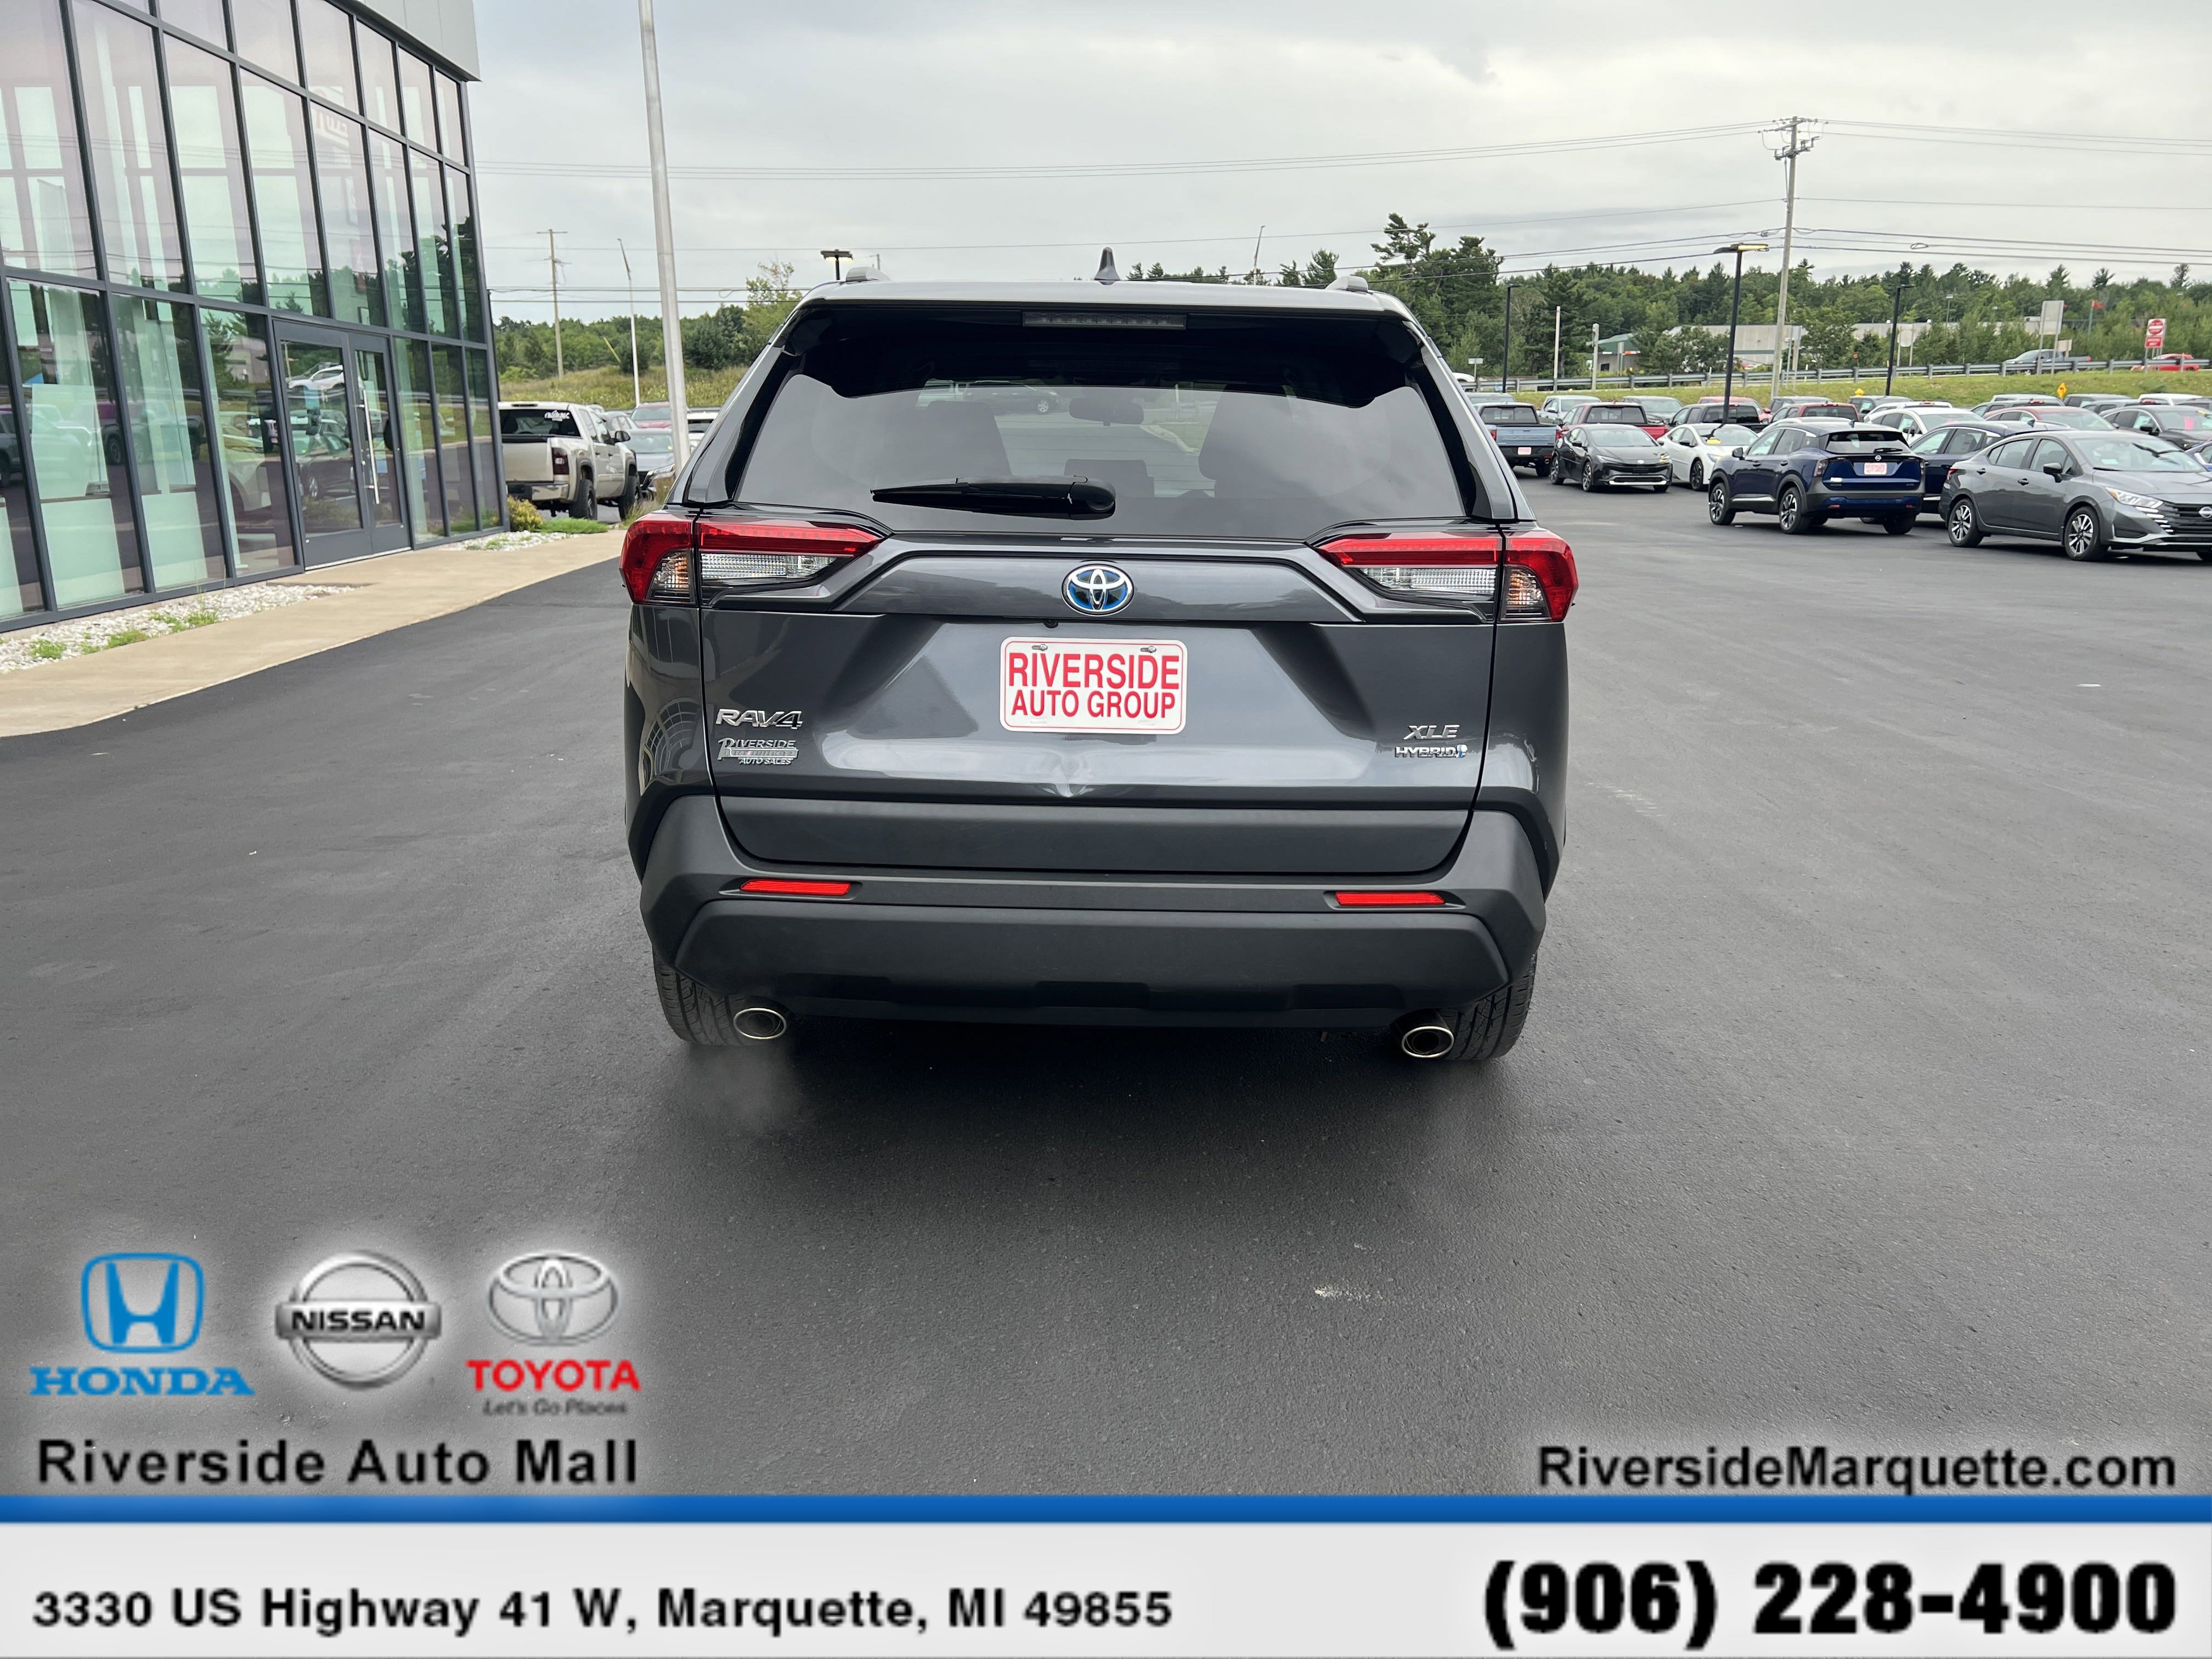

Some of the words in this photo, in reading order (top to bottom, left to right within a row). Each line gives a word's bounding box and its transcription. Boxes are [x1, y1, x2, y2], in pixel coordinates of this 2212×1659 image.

[1009, 652, 1179, 689] RIVERSIDE
[1011, 690, 1079, 717] AUTO
[1087, 691, 1175, 718] GROUP
[715, 708, 803, 730] RAV4
[1403, 724, 1460, 740] XLE
[717, 737, 797, 761] RIVERSIDE
[1395, 746, 1457, 758] HYBRID
